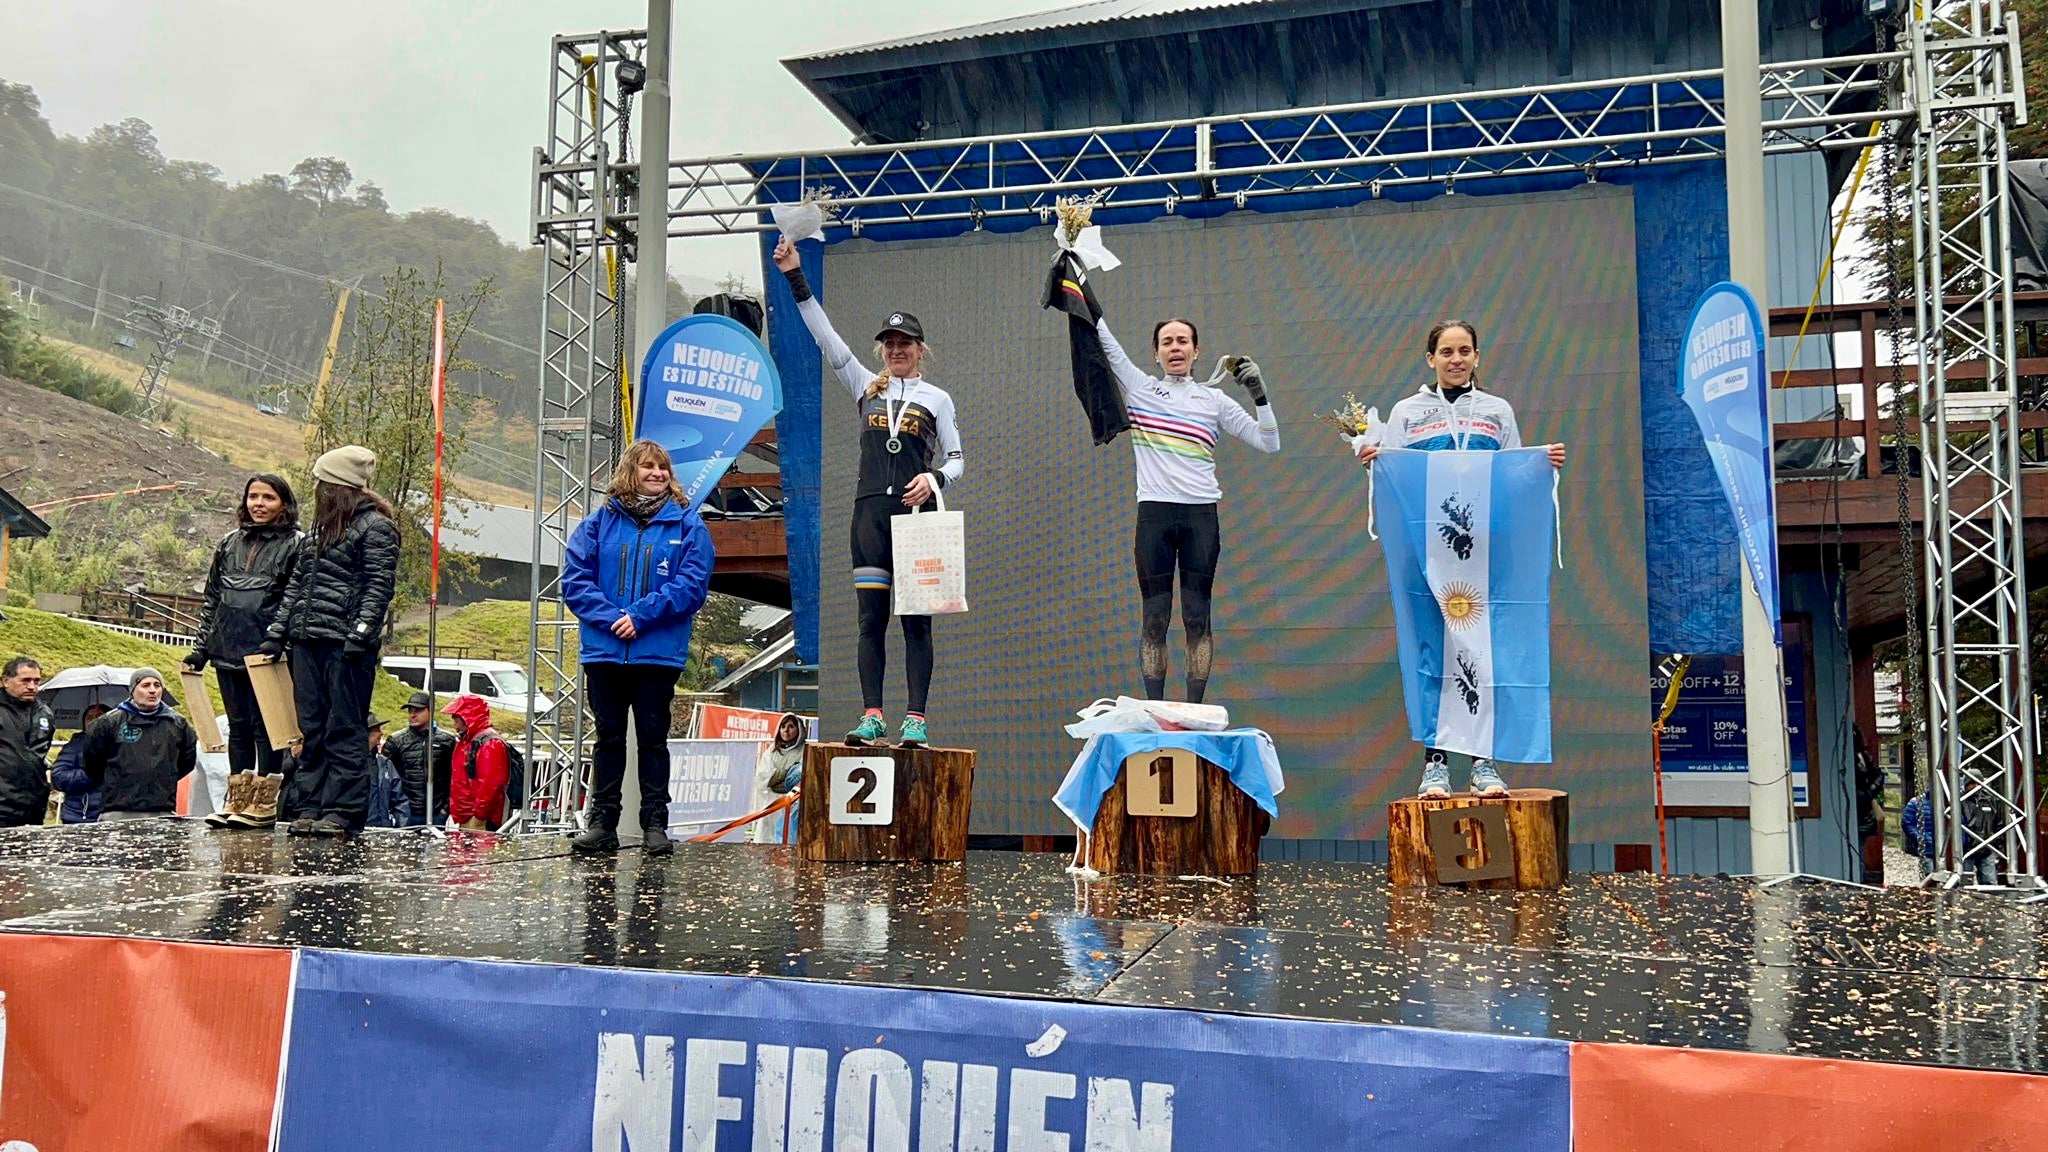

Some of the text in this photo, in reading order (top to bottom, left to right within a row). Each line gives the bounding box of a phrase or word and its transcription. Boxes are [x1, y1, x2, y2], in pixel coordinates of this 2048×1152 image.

[673, 342, 760, 381] NEUQUÉN
[662, 366, 763, 400] ES TU DESTINO
[673, 396, 706, 407] NEUQUÉN
[868, 414, 920, 436] KEZA
[1723, 674, 1740, 686] 12
[1723, 687, 1739, 695] sin
[726, 714, 769, 732] NEUQUÉN
[1713, 721, 1738, 731] 10%
[1713, 731, 1734, 740] OFF
[845, 767, 878, 814] 2
[1149, 756, 1174, 805] 1
[1453, 817, 1489, 870] 3
[592, 1023, 1175, 1152] NEUQUÉN
